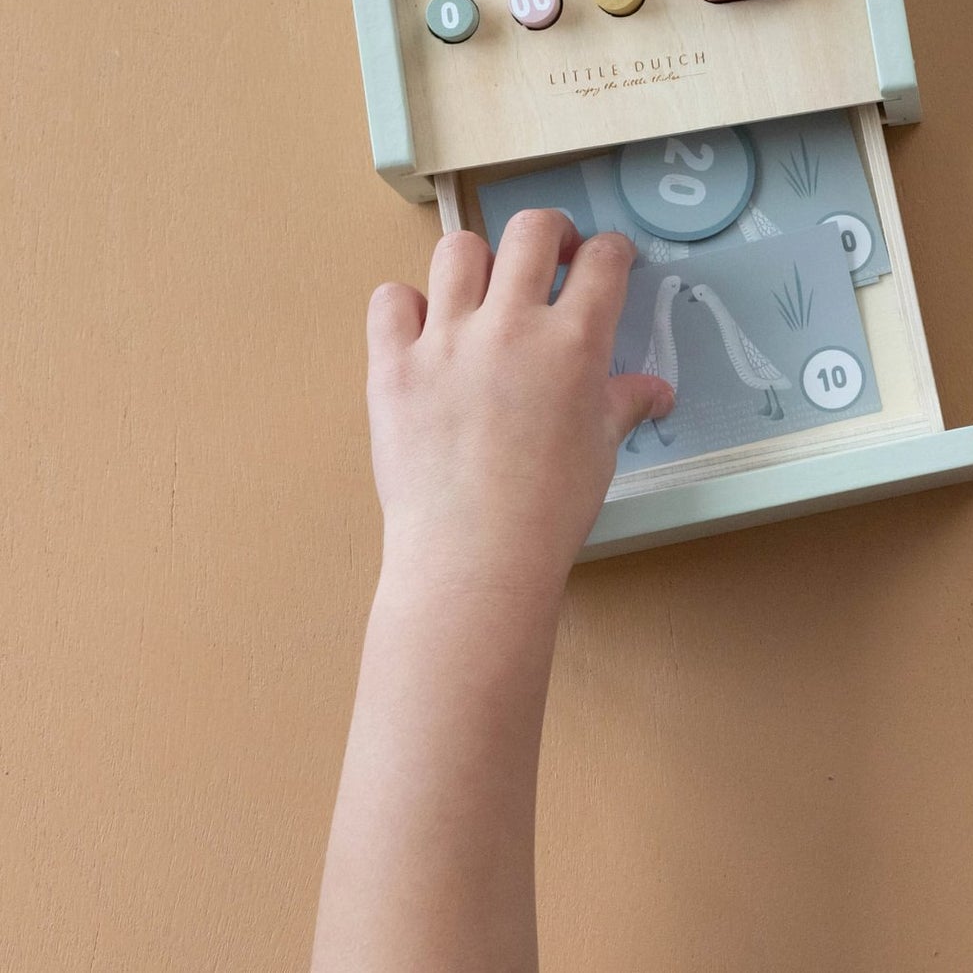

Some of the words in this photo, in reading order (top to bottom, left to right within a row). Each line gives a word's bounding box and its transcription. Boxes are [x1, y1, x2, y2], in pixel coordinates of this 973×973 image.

[441, 1, 460, 29] 0
[549, 64, 619, 85] LITTLE
[634, 51, 706, 73] DUTCH
[659, 137, 715, 206] 20
[840, 229, 857, 253] 0
[816, 364, 848, 393] 10
